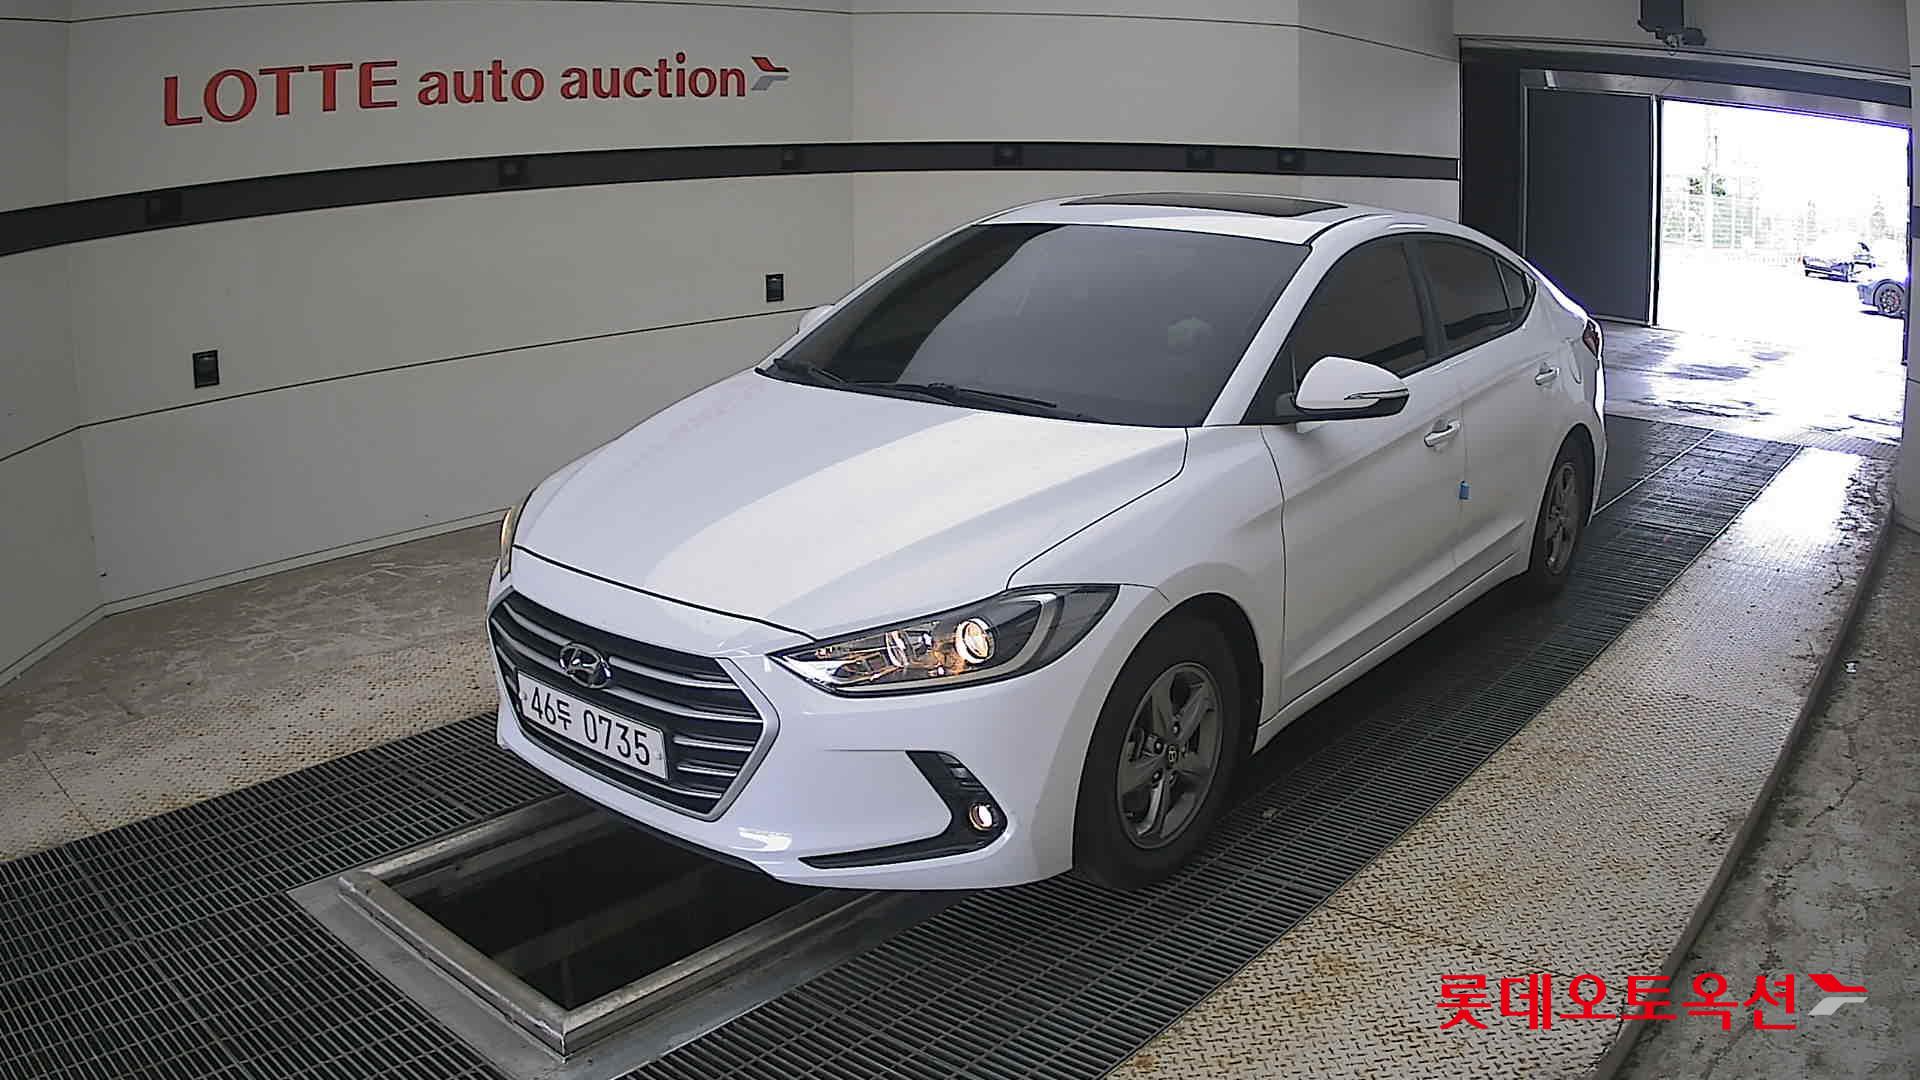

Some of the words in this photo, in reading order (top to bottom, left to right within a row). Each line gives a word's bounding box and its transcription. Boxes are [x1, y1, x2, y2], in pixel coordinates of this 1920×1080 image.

[163, 60, 398, 126] LOTTE
[416, 58, 545, 106] auto
[560, 51, 747, 99] auction
[531, 686, 572, 731] 46두
[583, 709, 650, 766] 0735
